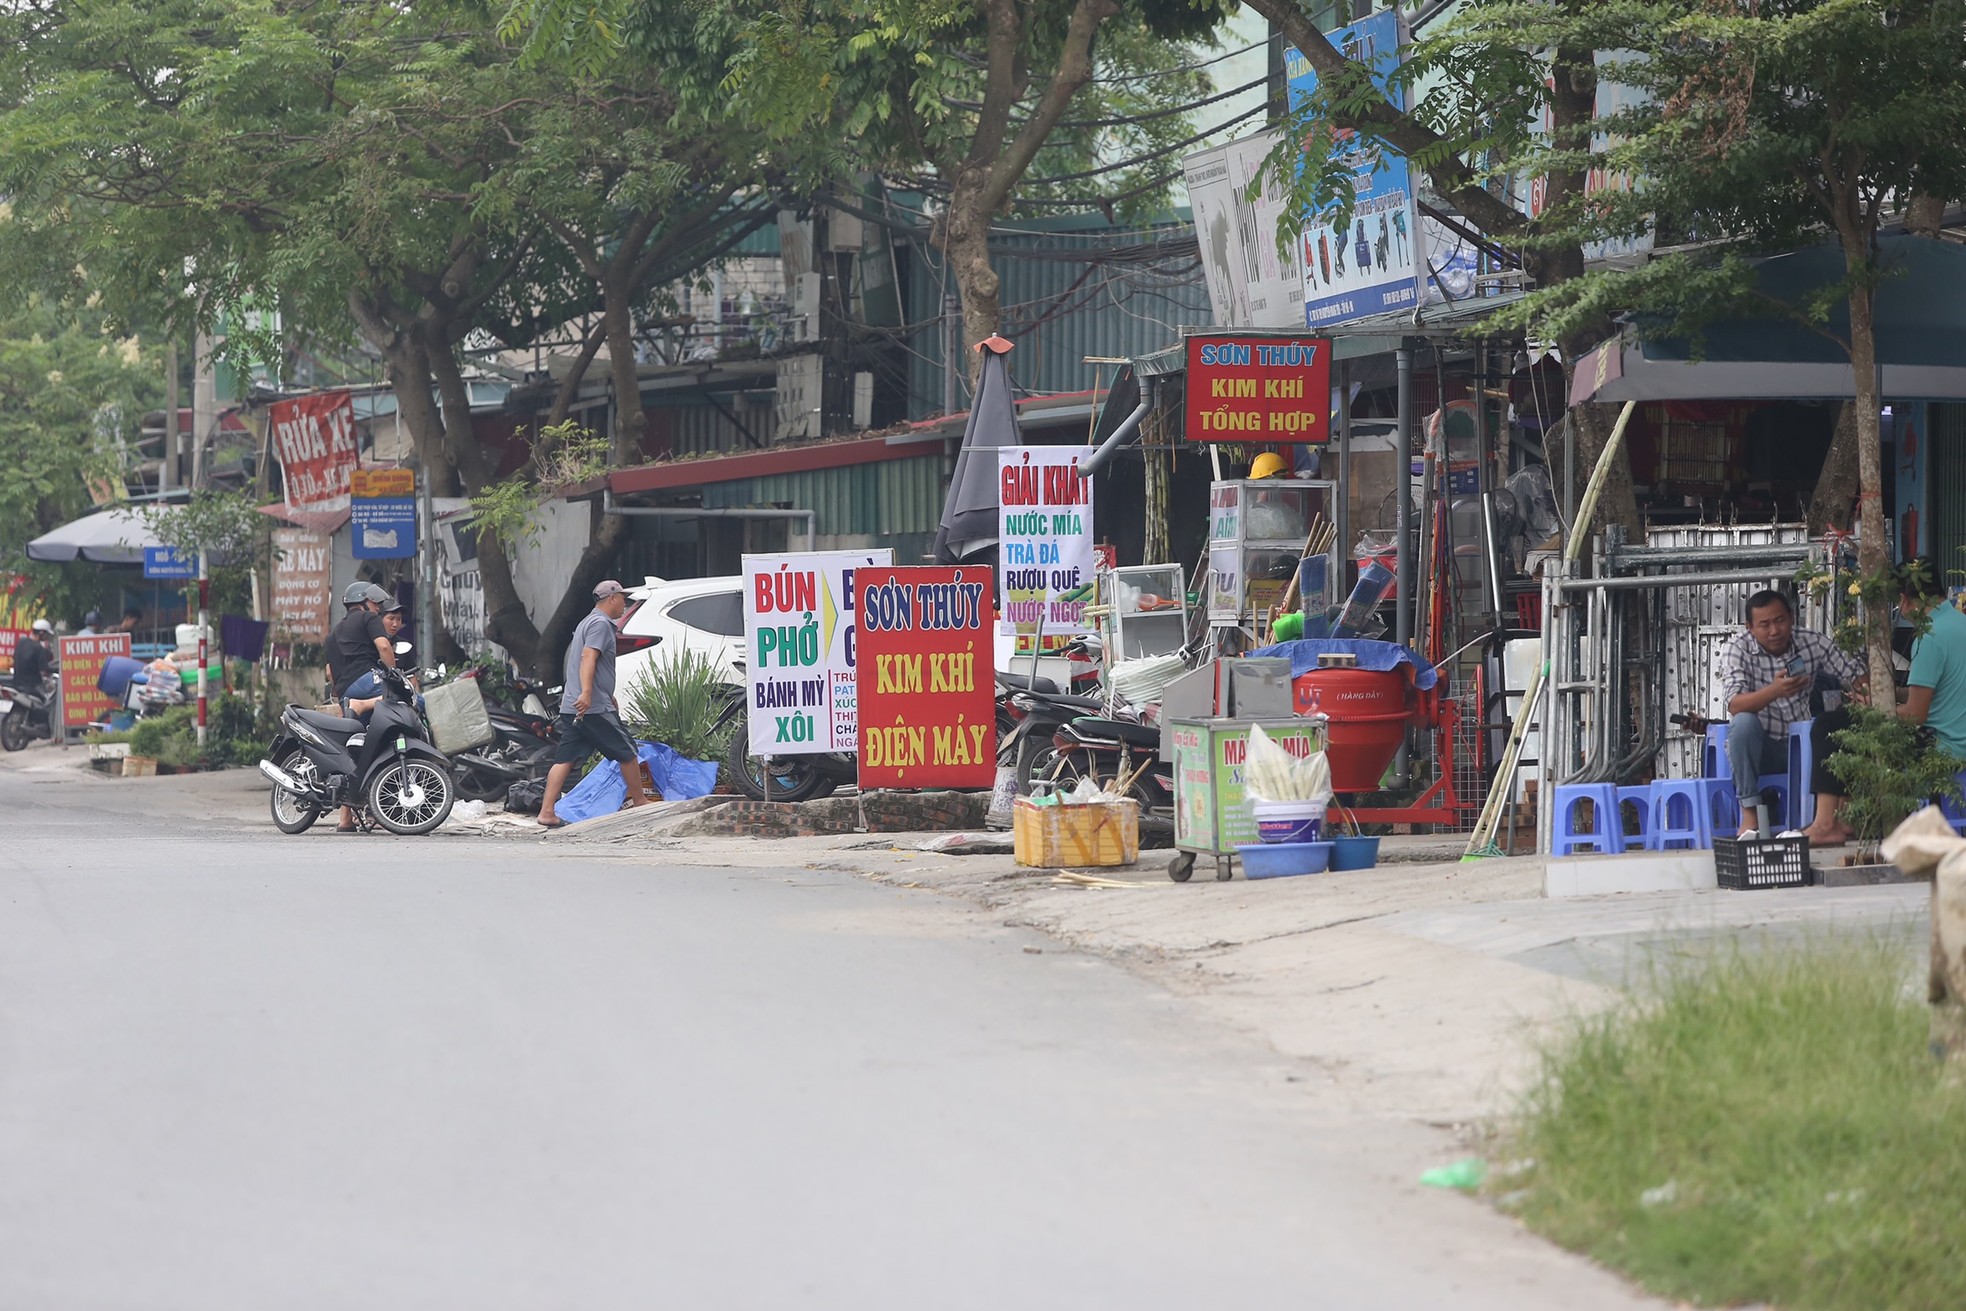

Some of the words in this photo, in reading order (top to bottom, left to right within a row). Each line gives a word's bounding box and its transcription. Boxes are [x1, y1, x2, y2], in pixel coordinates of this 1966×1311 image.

[1201, 342, 1251, 366] SƠN
[1256, 341, 1317, 367] THÚY
[1211, 378, 1257, 398] KIM
[1264, 375, 1304, 399] KHÍ
[278, 404, 328, 465] RỬA
[325, 406, 355, 455] XE
[1200, 403, 1261, 431] TỔNG
[1269, 410, 1316, 436] HỢP
[1001, 451, 1039, 506] GIẢI
[1006, 510, 1047, 535] NƯỚC
[1052, 510, 1082, 535] MÍA
[298, 545, 325, 572] MÁY
[1006, 539, 1035, 564] TRÀ
[1039, 539, 1060, 564] ĐÁ
[754, 563, 817, 613] BÚN
[1006, 568, 1046, 594] RƯỢU
[1051, 566, 1080, 592] QUÊ
[864, 575, 912, 631] SƠN
[917, 569, 983, 630] THÚY
[66, 641, 94, 655] KIM
[99, 635, 123, 653] KHÍ
[757, 611, 819, 668] PHỞ
[834, 670, 856, 682] TRÚ
[876, 653, 923, 694] KIM
[929, 640, 975, 693] KHÍ
[756, 676, 797, 708] BÁNH
[802, 674, 825, 706] MỲ
[834, 685, 854, 695] PAT
[775, 710, 814, 743] XÔI
[866, 714, 926, 778] ĐIỆN
[932, 713, 988, 766] MÁY
[1224, 733, 1249, 766] MÁ
